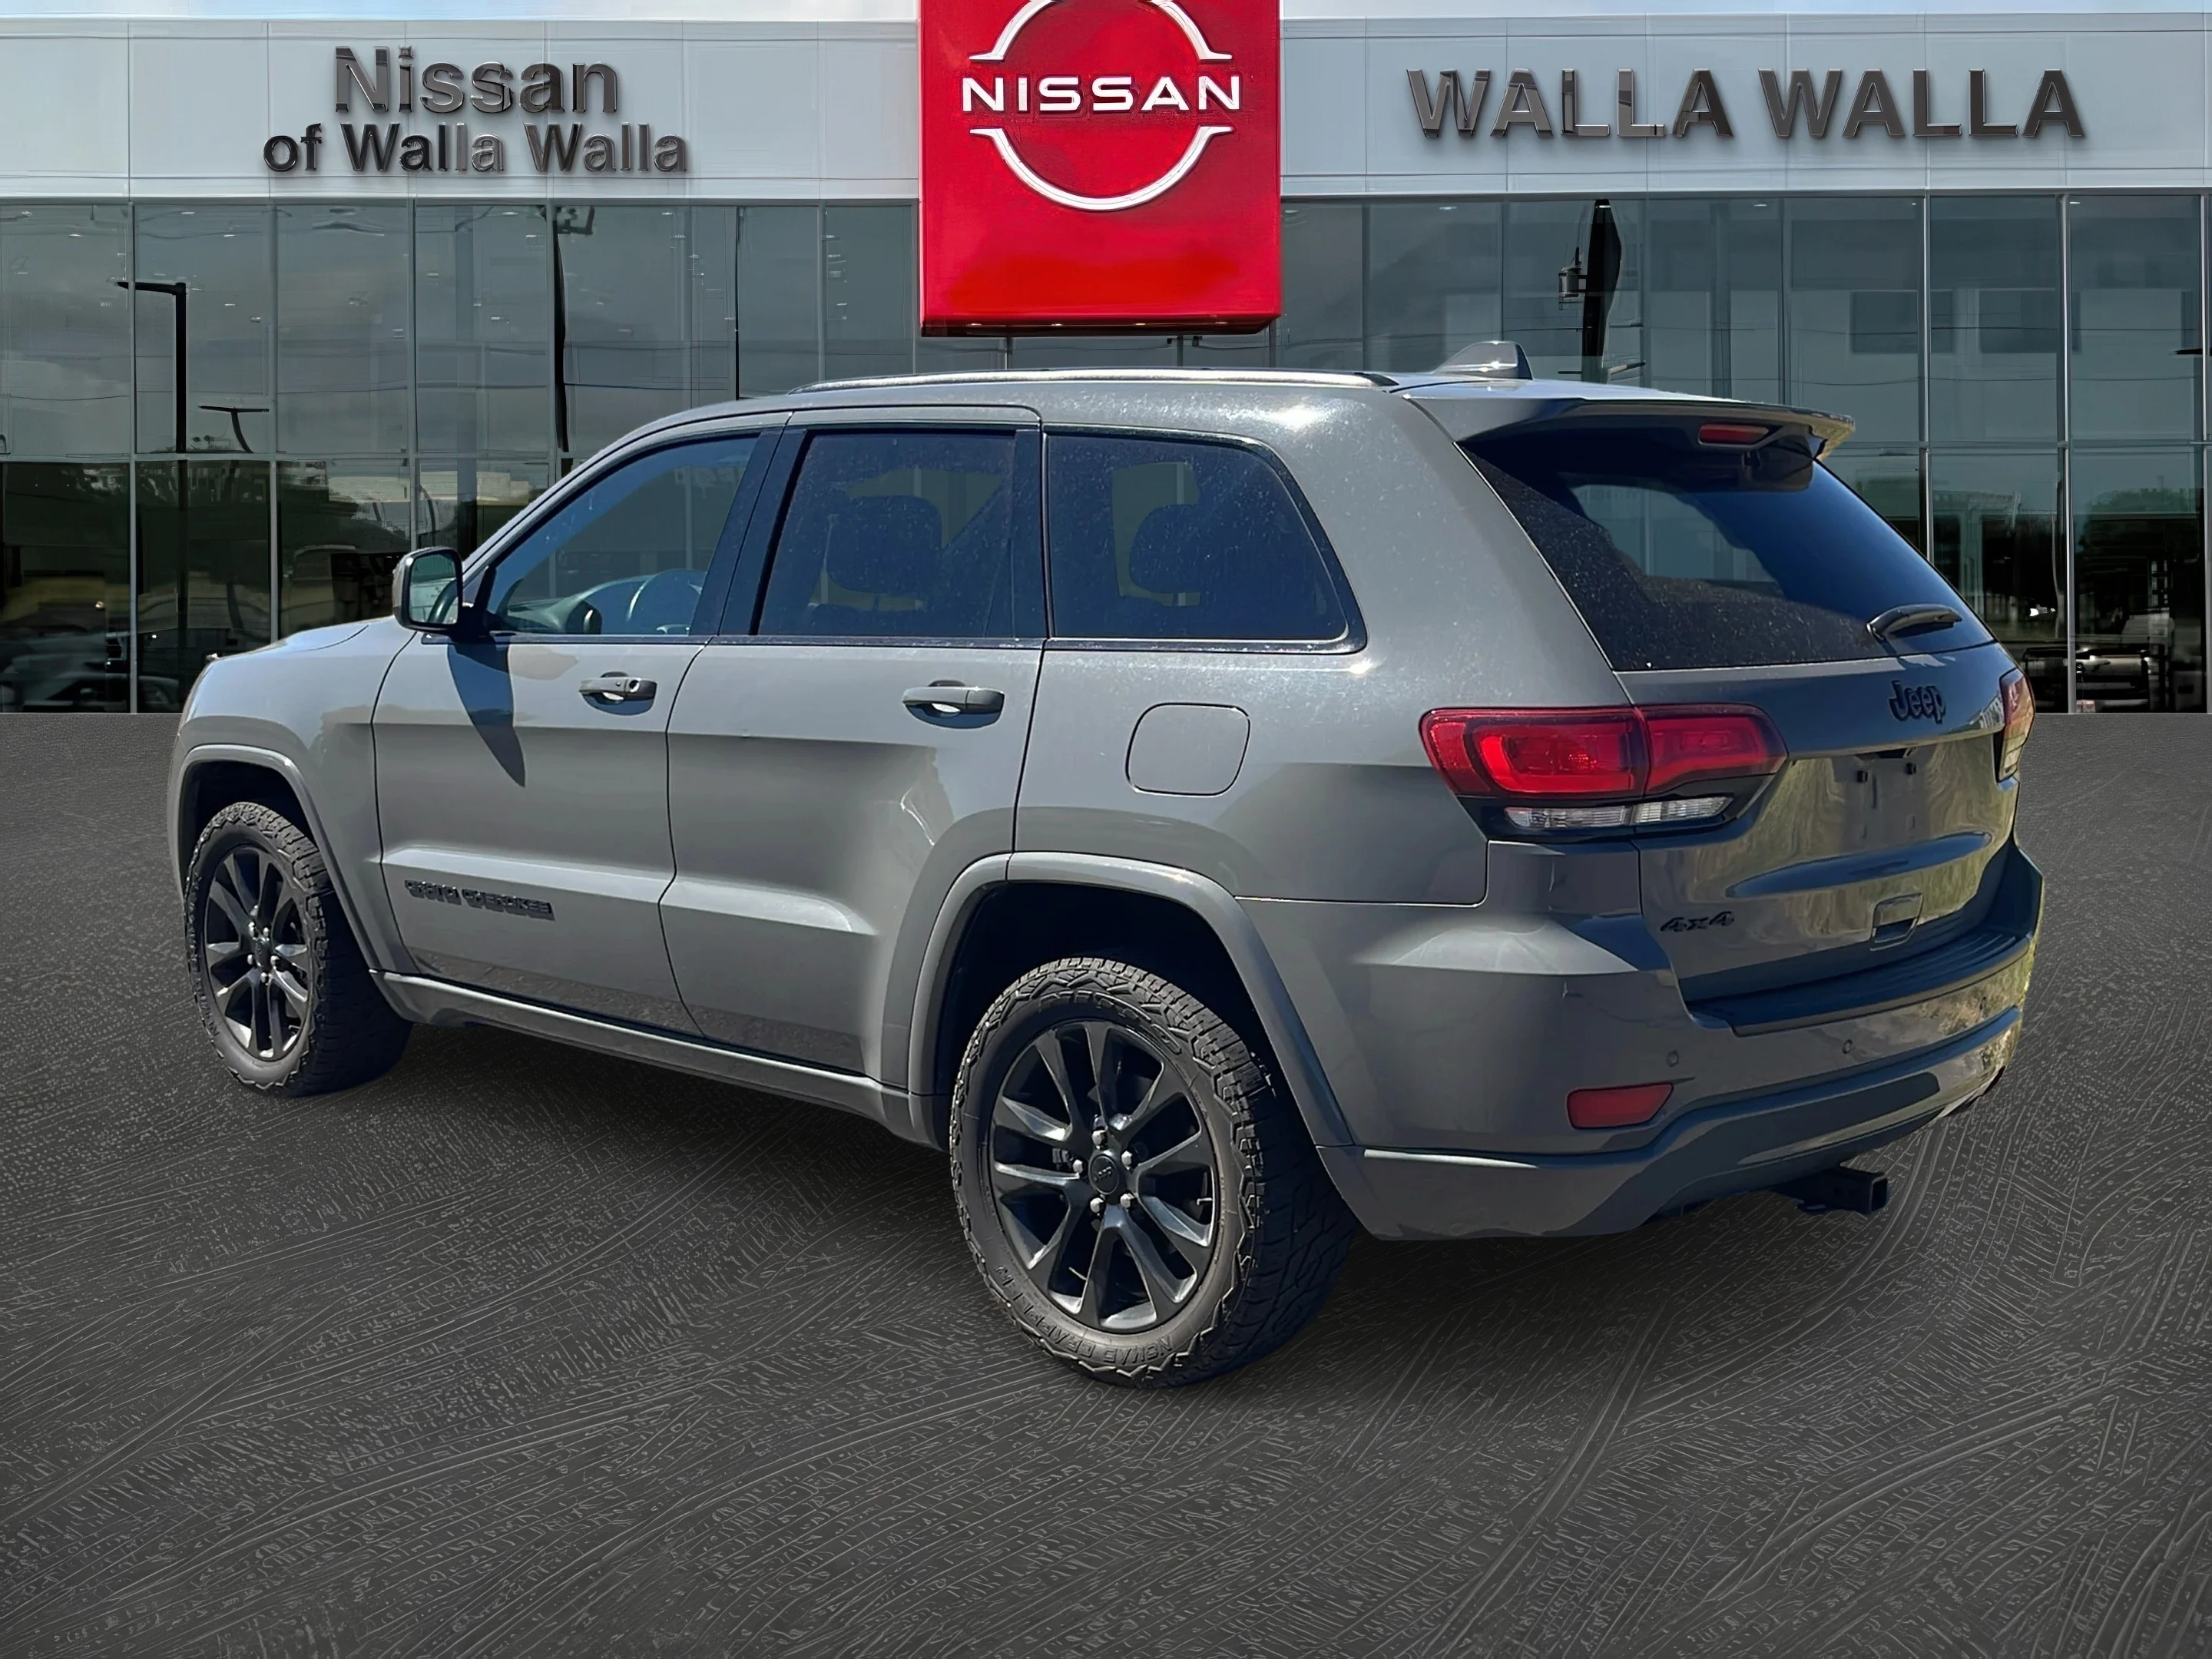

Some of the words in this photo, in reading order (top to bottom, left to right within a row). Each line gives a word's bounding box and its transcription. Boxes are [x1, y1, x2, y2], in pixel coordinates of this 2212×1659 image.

[336, 45, 618, 113] Nissan
[962, 75, 1240, 112] NISSAN
[1406, 68, 1734, 138] WALLA
[1758, 68, 2087, 138] WALLA
[263, 123, 323, 171] of
[340, 122, 504, 172] Walla
[523, 122, 687, 172] Walla
[1888, 680, 1945, 724] Jeep
